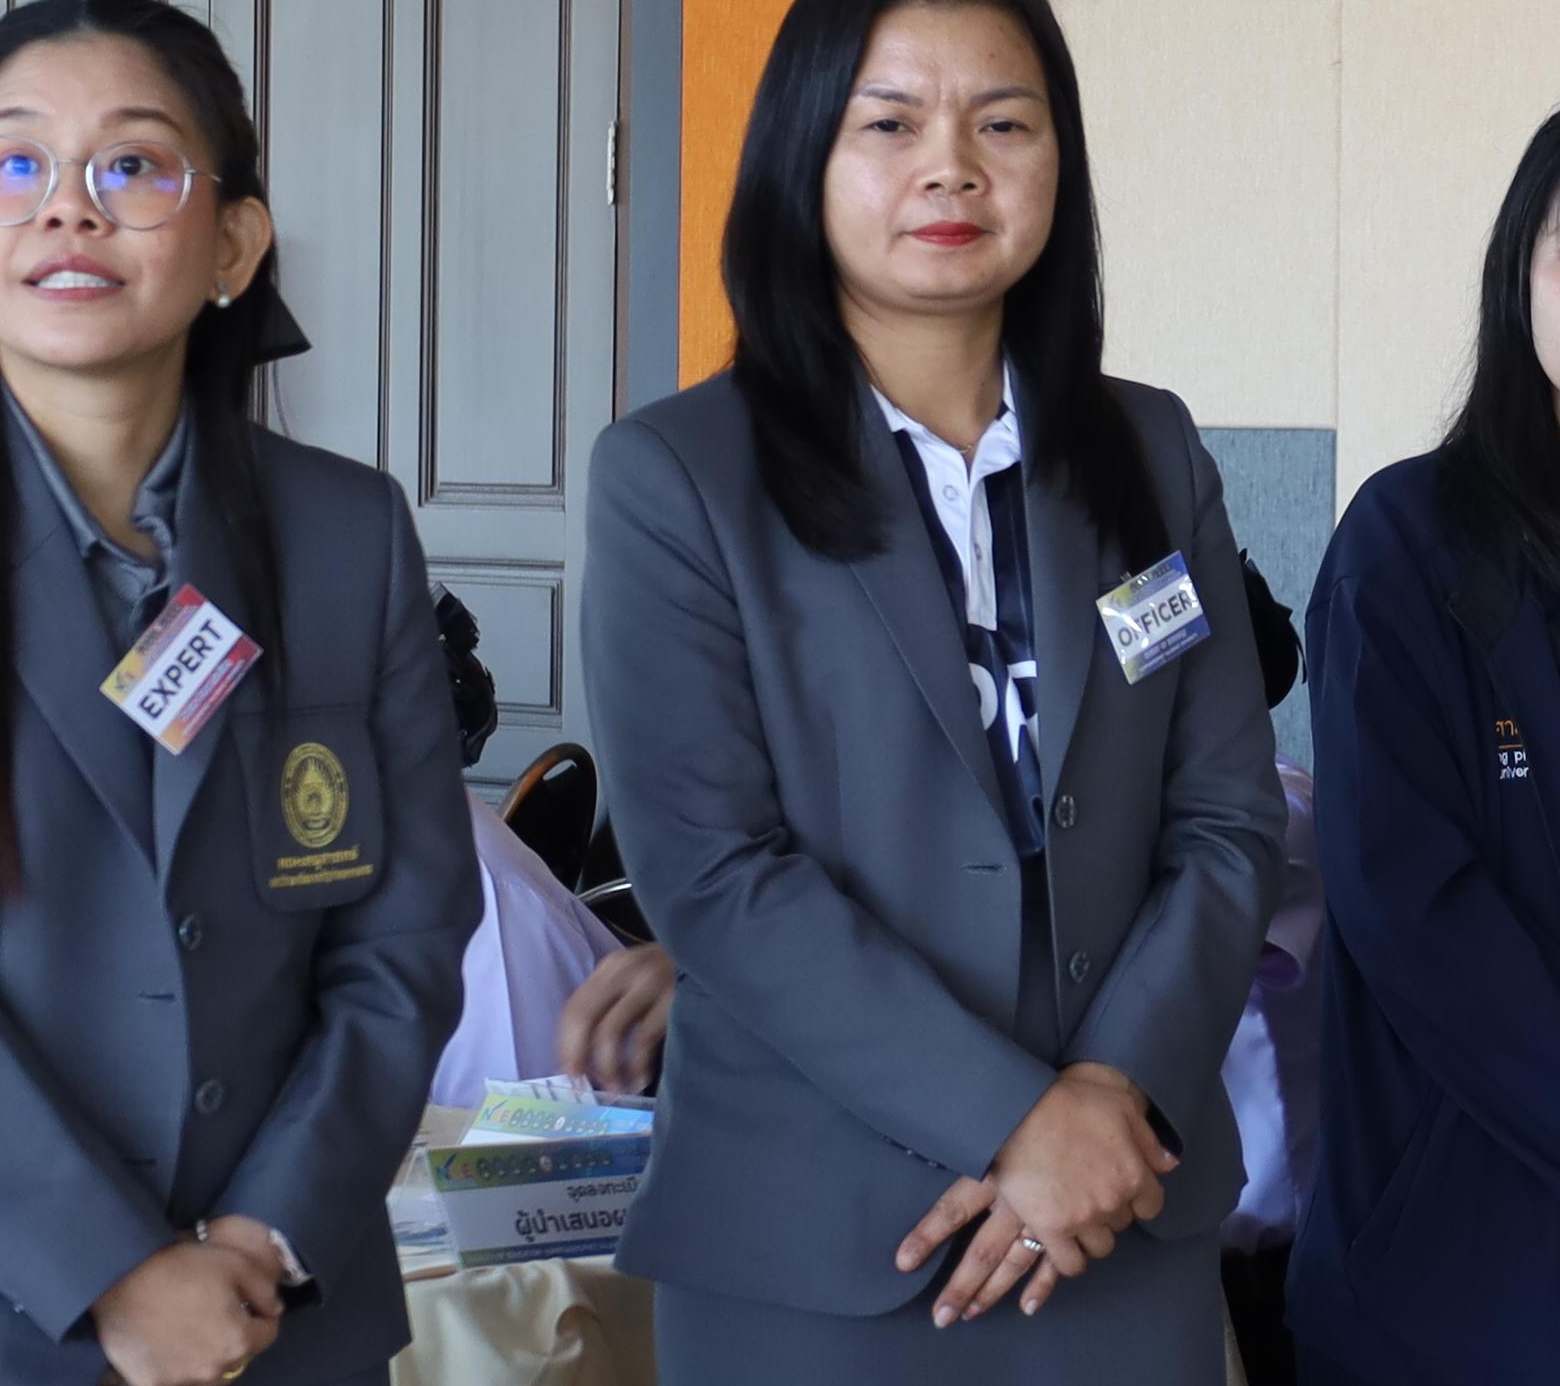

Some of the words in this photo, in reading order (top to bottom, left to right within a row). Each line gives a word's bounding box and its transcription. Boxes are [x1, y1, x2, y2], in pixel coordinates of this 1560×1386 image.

[139, 619, 222, 720] EXPERT
[515, 1207, 628, 1243] ผู้นำเสนอผ
